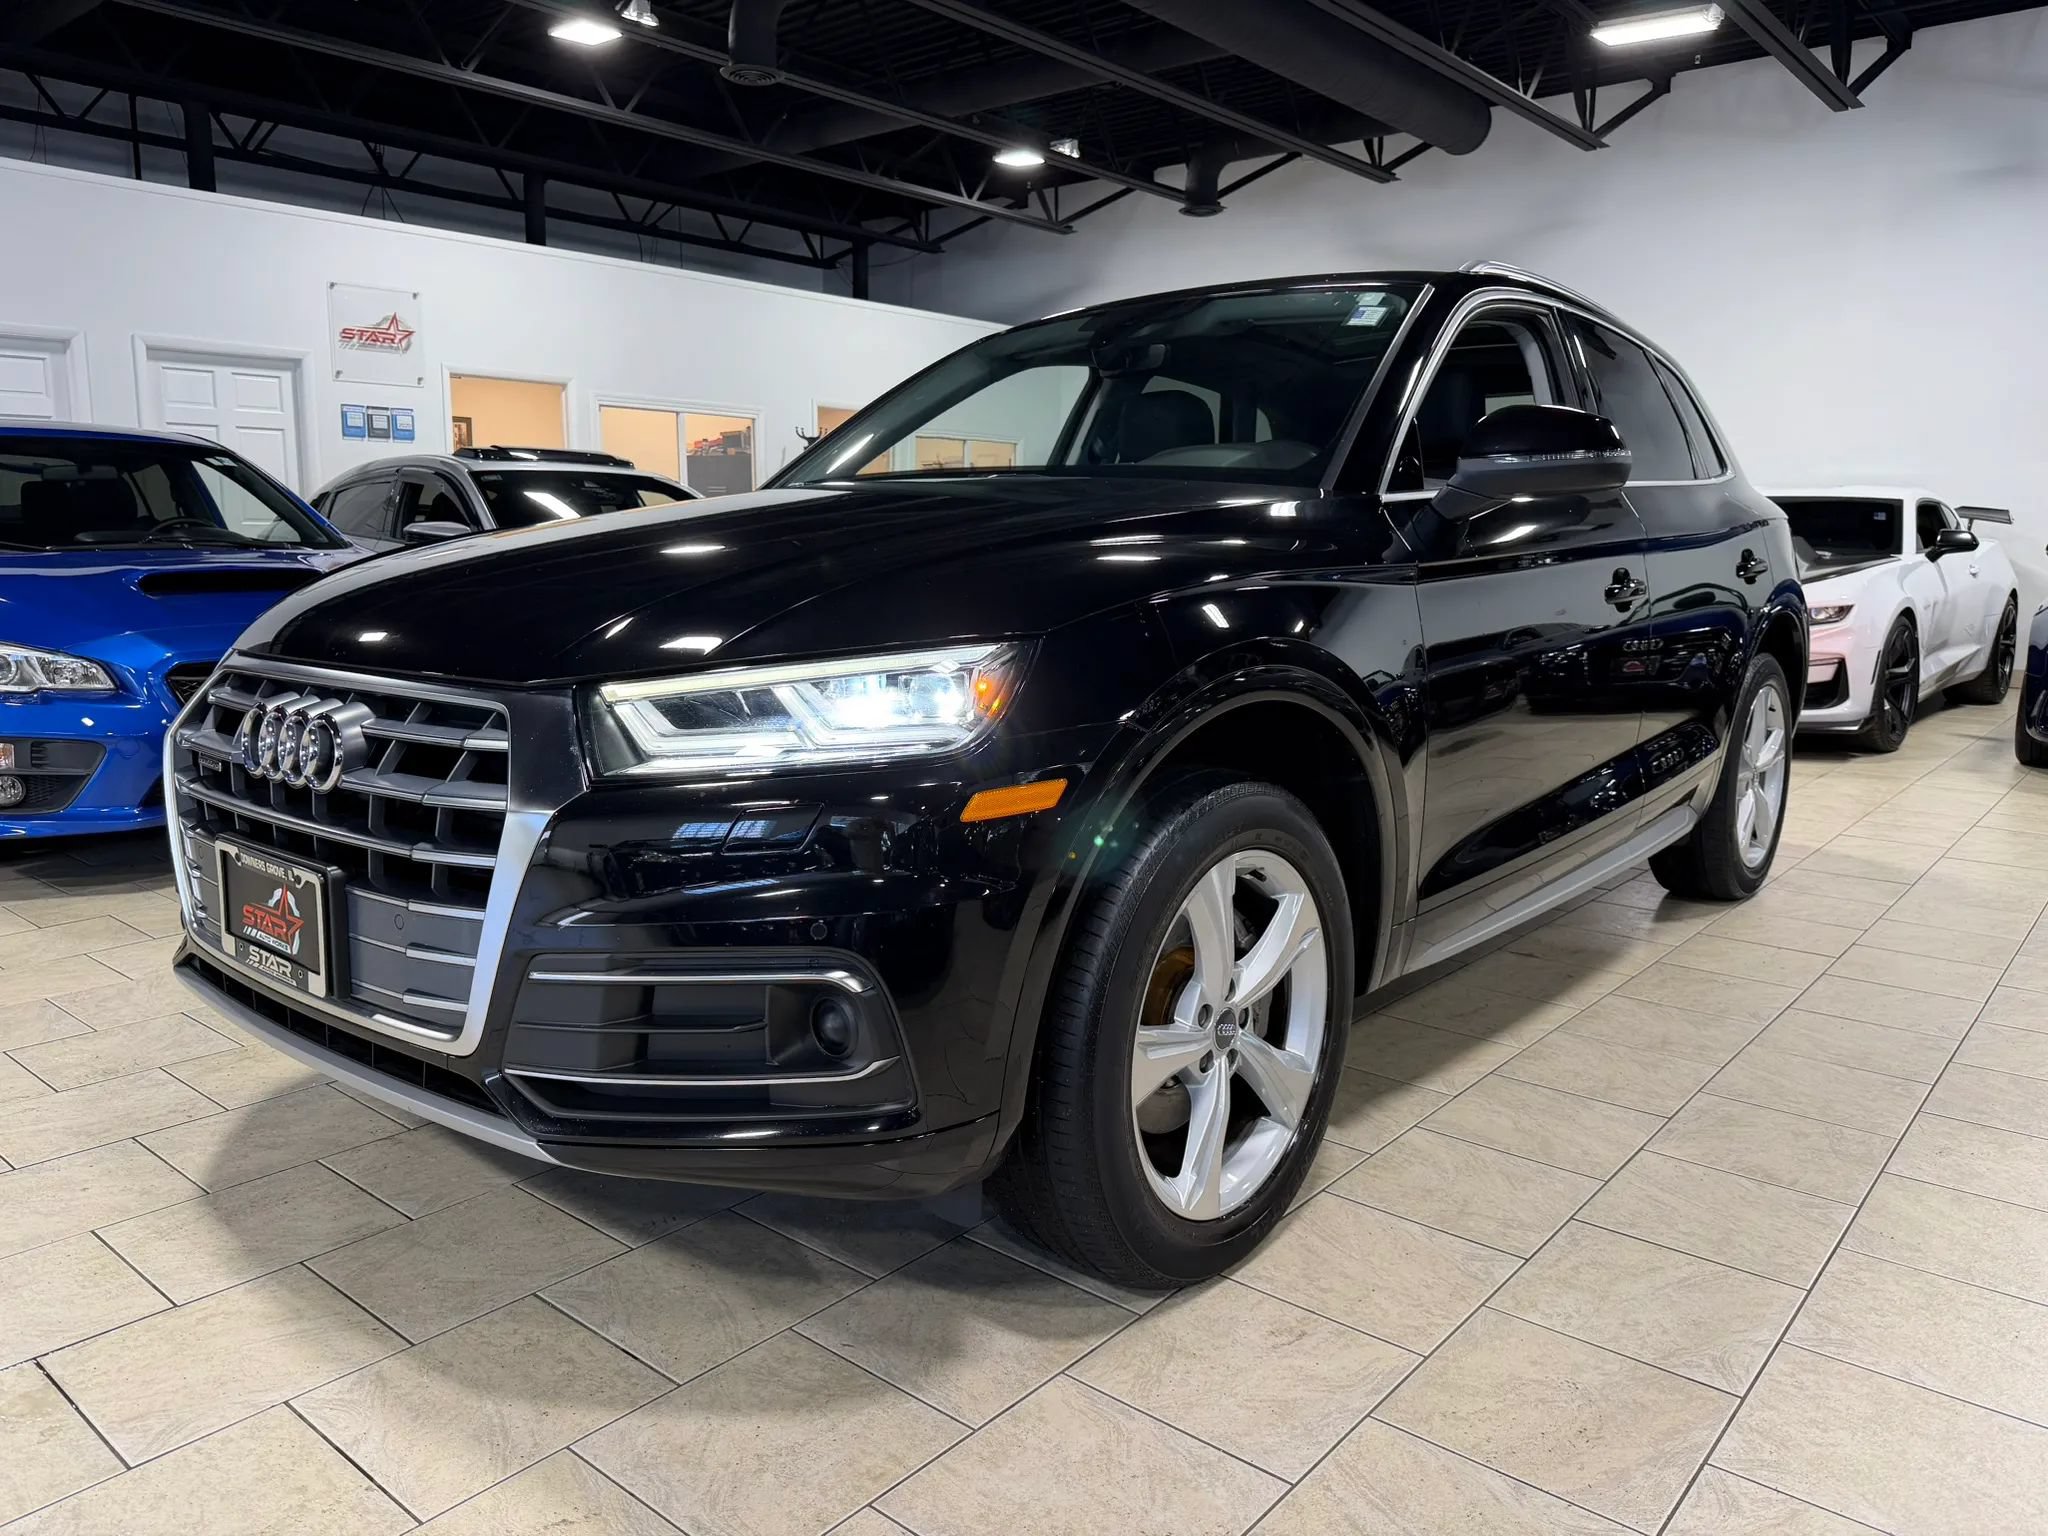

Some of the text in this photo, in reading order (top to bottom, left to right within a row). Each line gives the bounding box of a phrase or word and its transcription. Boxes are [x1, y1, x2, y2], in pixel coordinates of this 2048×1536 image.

[341, 327, 398, 344] STAR
[240, 852, 266, 871] DOWNERS
[242, 905, 287, 940] STAR
[249, 944, 292, 977] STAR
